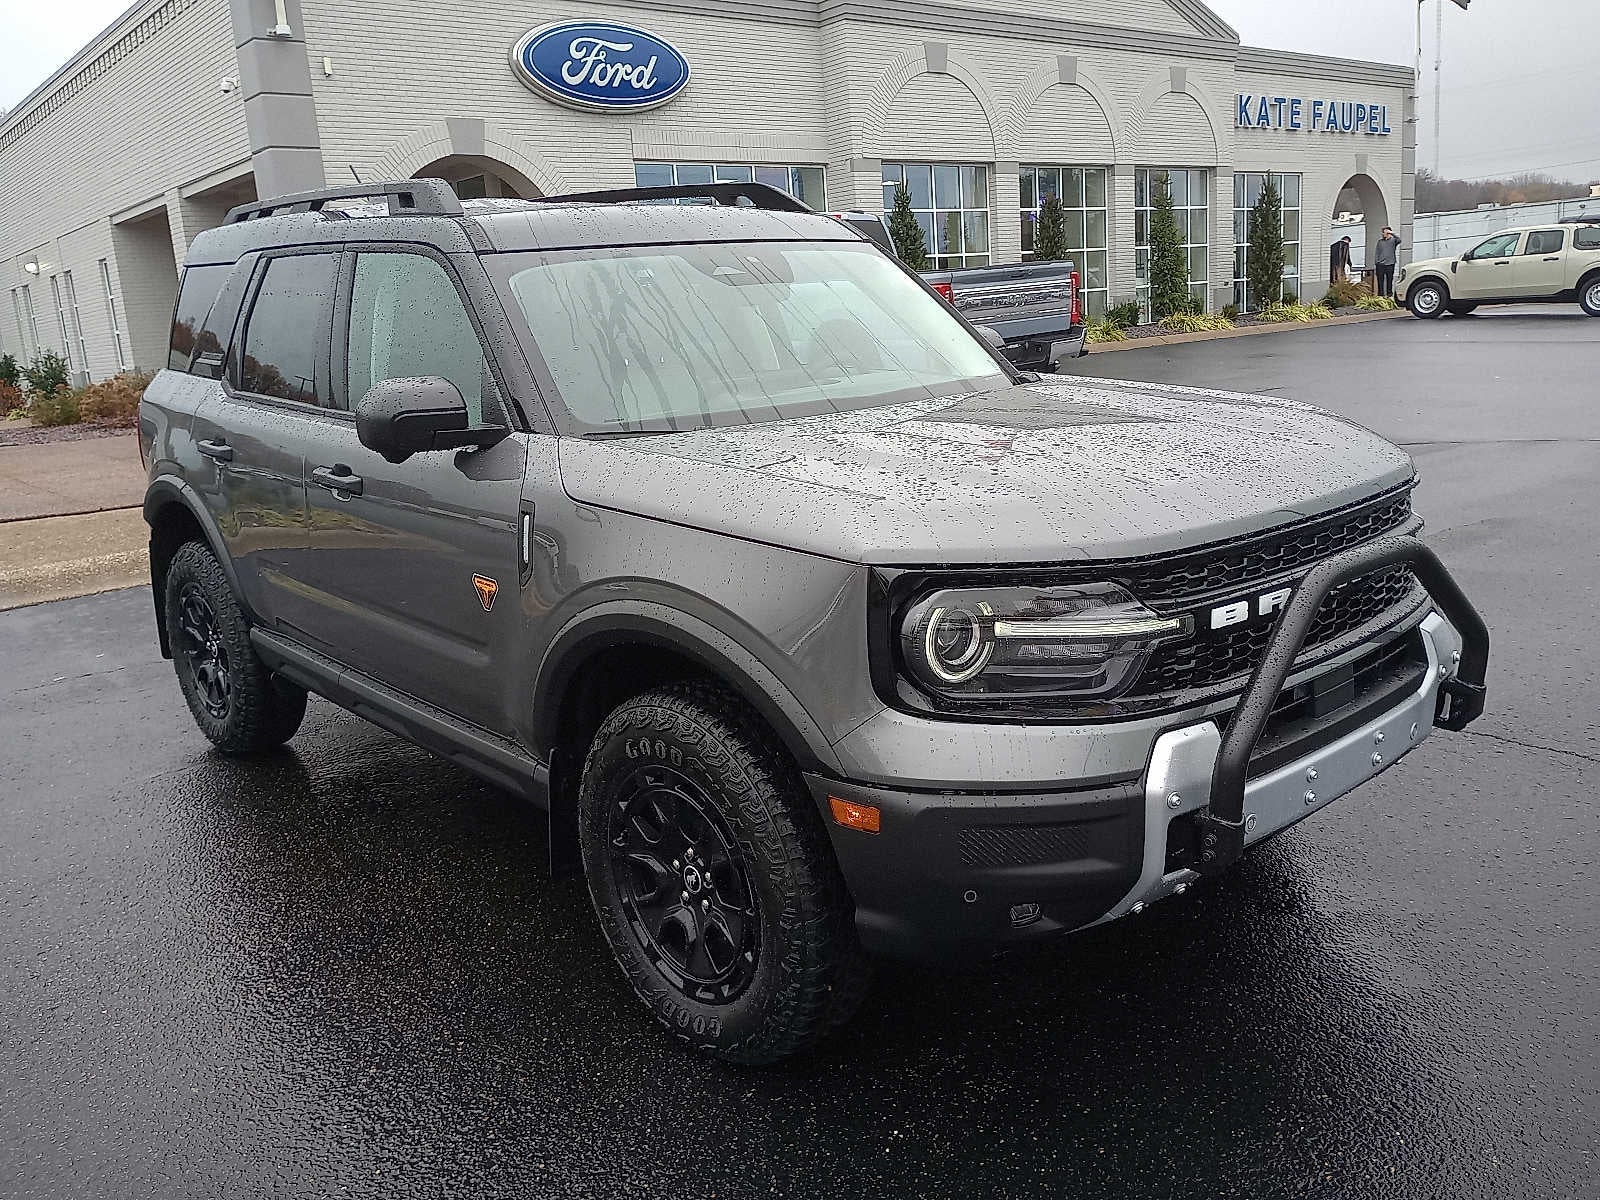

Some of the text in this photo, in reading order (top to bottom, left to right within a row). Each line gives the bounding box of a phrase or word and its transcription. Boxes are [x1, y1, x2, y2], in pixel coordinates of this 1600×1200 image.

[561, 36, 658, 90] Ford
[1237, 94, 1392, 134] KATE FAUPEL
